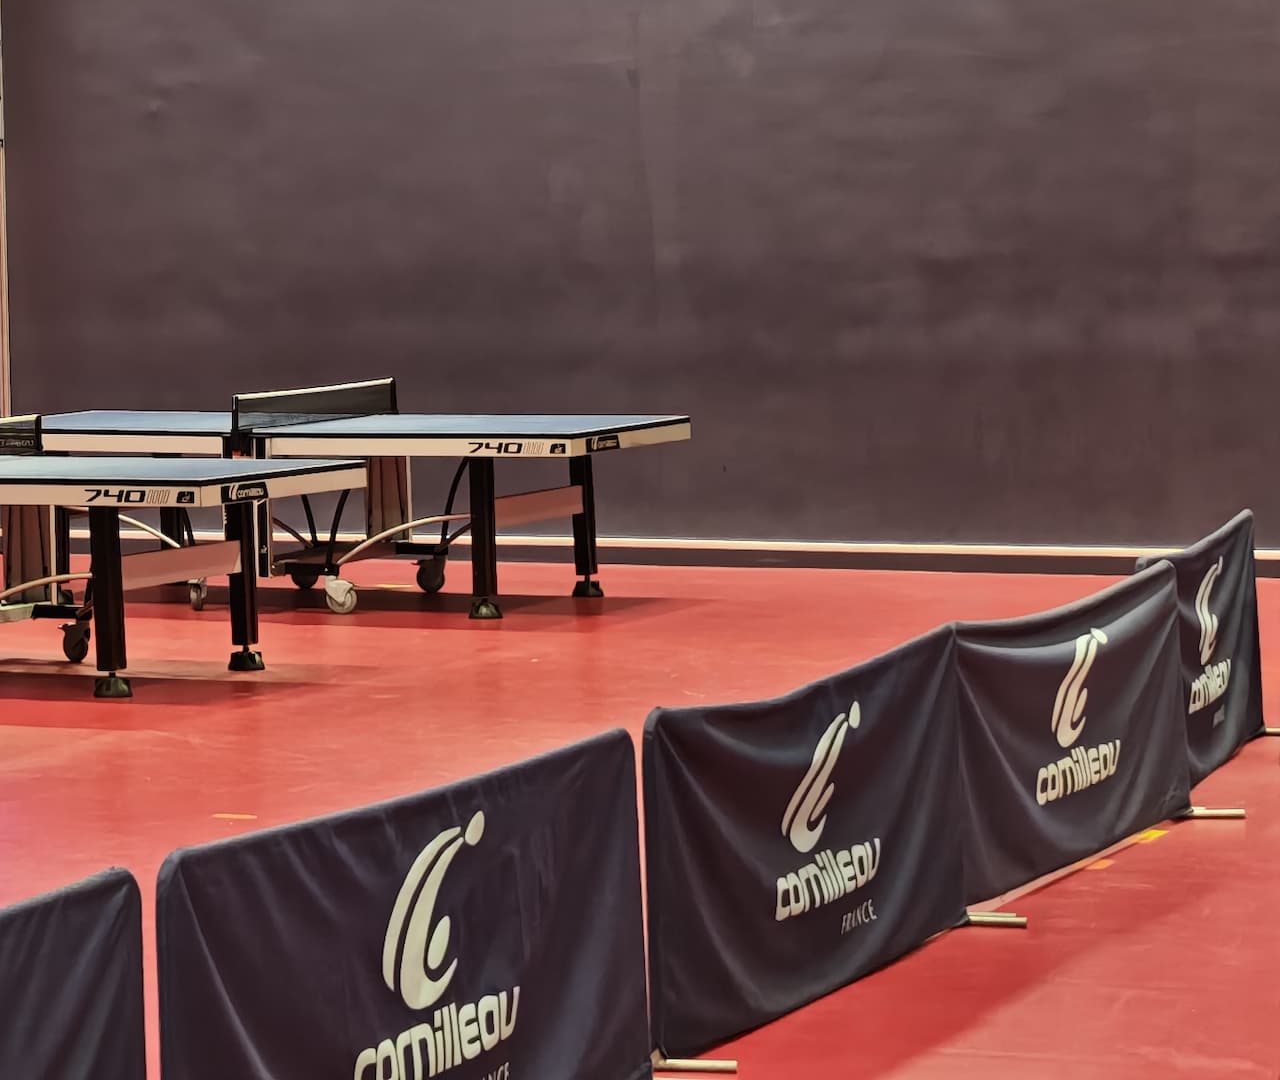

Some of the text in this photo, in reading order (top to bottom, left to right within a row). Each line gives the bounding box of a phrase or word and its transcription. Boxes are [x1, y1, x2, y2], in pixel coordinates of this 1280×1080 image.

[467, 442, 524, 455] 740
[84, 489, 146, 503] 740
[1036, 739, 1121, 806] cornilleau
[775, 837, 881, 922] cornilleau
[353, 985, 521, 1080] cornilleau
